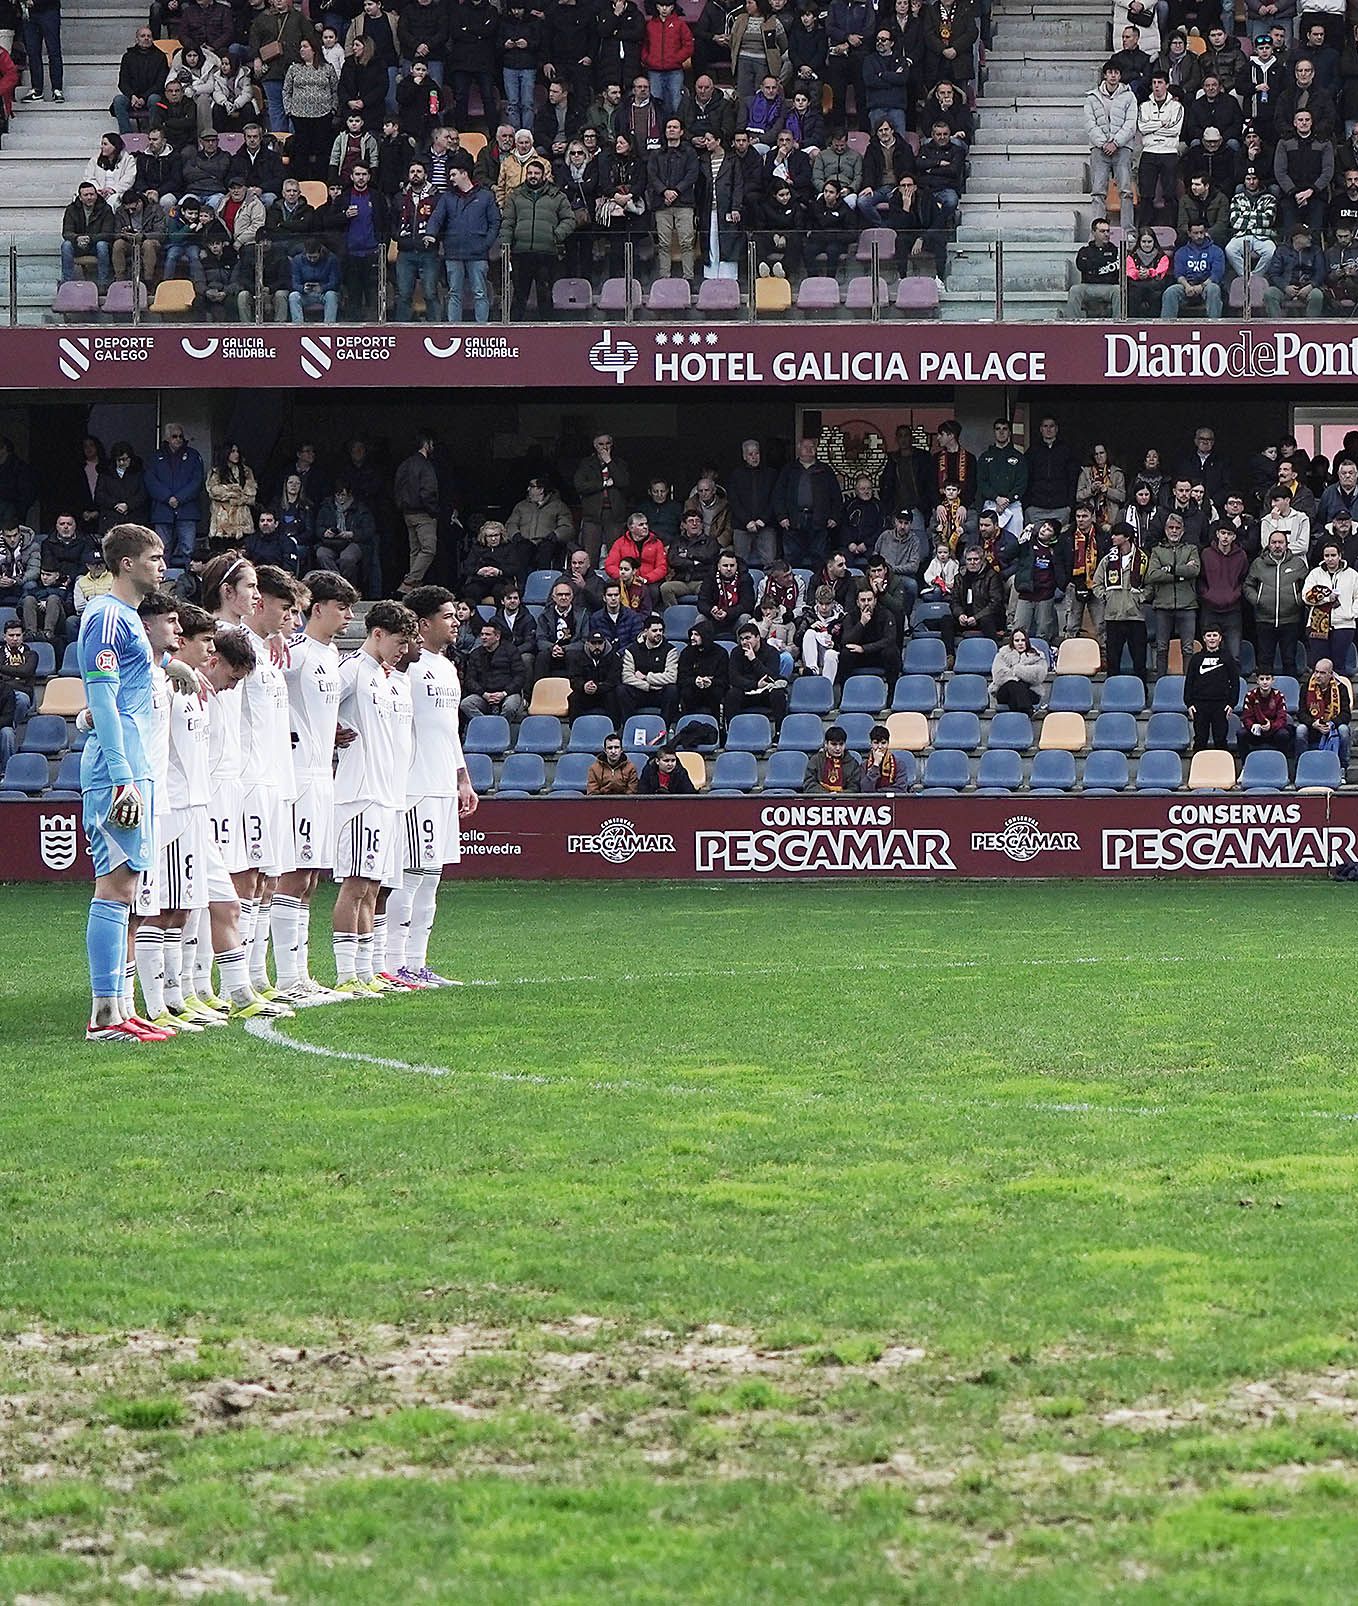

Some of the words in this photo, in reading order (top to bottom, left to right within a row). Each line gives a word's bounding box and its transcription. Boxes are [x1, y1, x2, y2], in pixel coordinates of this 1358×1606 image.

[95, 338, 154, 348] DEPORTE
[222, 338, 264, 347] GALICIA
[336, 337, 396, 348] DEPORTE
[464, 338, 507, 347] GALICIA
[95, 350, 148, 360] GALEGO
[222, 348, 276, 358] SAUDABLE
[336, 349, 390, 360] GALEGO
[464, 348, 519, 358] SAUDABLE
[655, 353, 763, 382] HOTEL
[773, 352, 909, 381] GALICIA
[921, 352, 1046, 381] PALACE
[761, 806, 894, 826] CONSERVAS
[1168, 804, 1301, 825] CONSERVAS
[210, 818, 229, 843] 15
[249, 815, 262, 841] 3
[299, 818, 311, 842] 4
[422, 819, 434, 842] 9
[459, 844, 522, 855] ontevedra
[568, 835, 676, 853] PESCAMAR
[971, 832, 1081, 850] PESCAMAR
[1102, 828, 1358, 870] PESCAMAR
[695, 830, 957, 871] PESCAMAR
